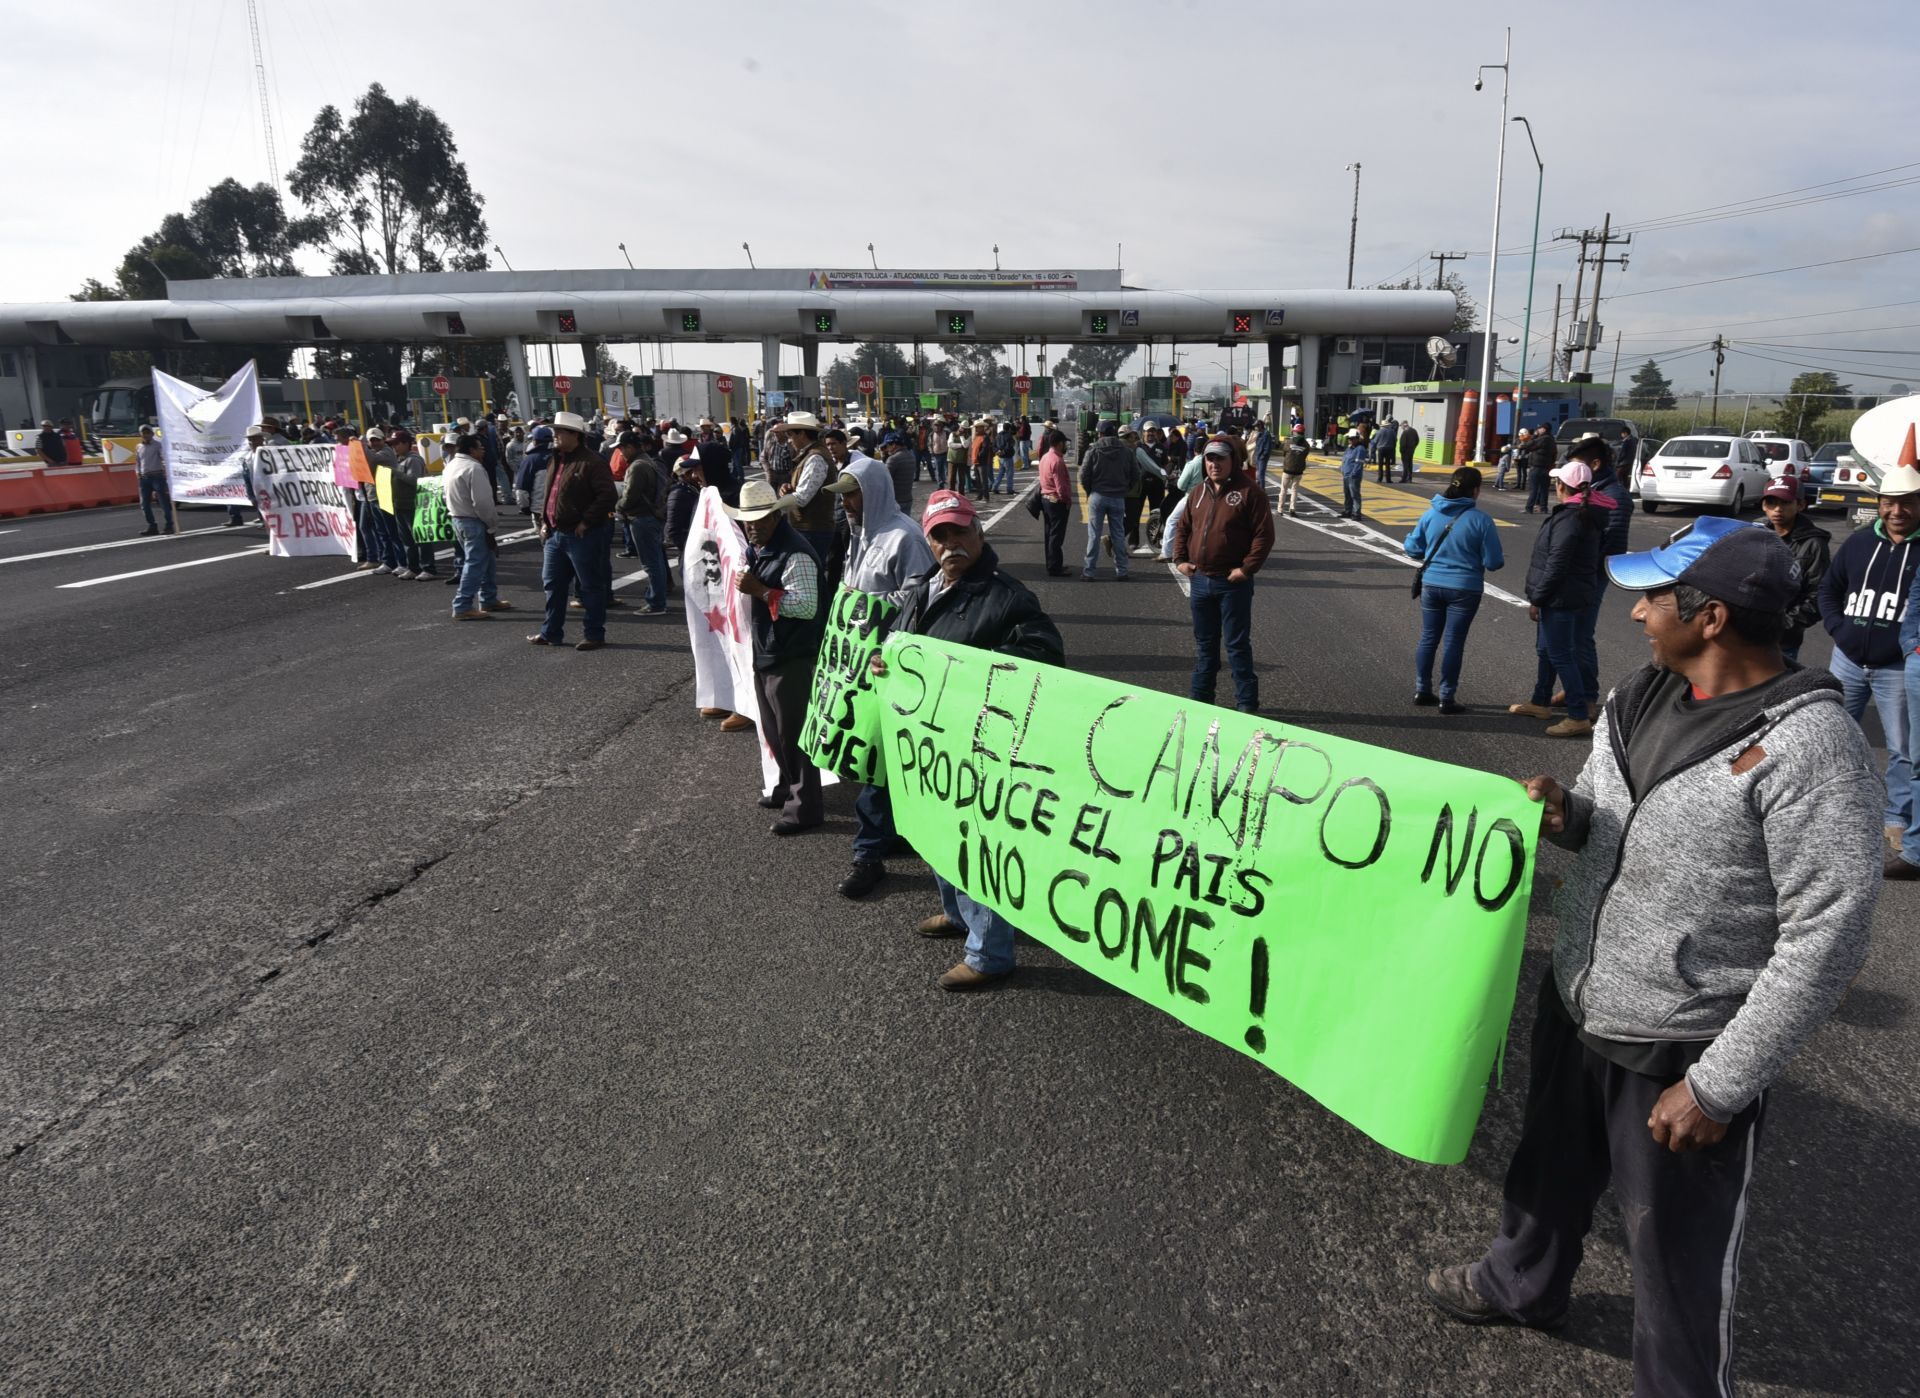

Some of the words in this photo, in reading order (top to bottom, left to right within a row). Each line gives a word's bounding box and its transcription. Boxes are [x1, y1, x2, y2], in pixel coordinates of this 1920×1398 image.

[893, 272, 939, 280] ATLACOMULCO
[717, 380, 733, 388] ALTO
[860, 381, 874, 389] ALTO
[1015, 381, 1031, 389] ALTO
[1175, 381, 1191, 389] ALTO
[1231, 407, 1243, 418] 17
[261, 449, 278, 475] SI
[278, 448, 300, 473] EL
[272, 480, 300, 508] NO
[265, 514, 288, 538] EL
[292, 512, 329, 538] PAIS
[436, 523, 454, 541] CO
[891, 644, 964, 733] SI
[971, 661, 1056, 776] EL
[1086, 694, 1392, 870] CAMPO
[1420, 801, 1526, 912] NO
[896, 727, 1061, 837] PRODUCE
[1068, 802, 1122, 865] EL
[1150, 828, 1274, 918] PAIS
